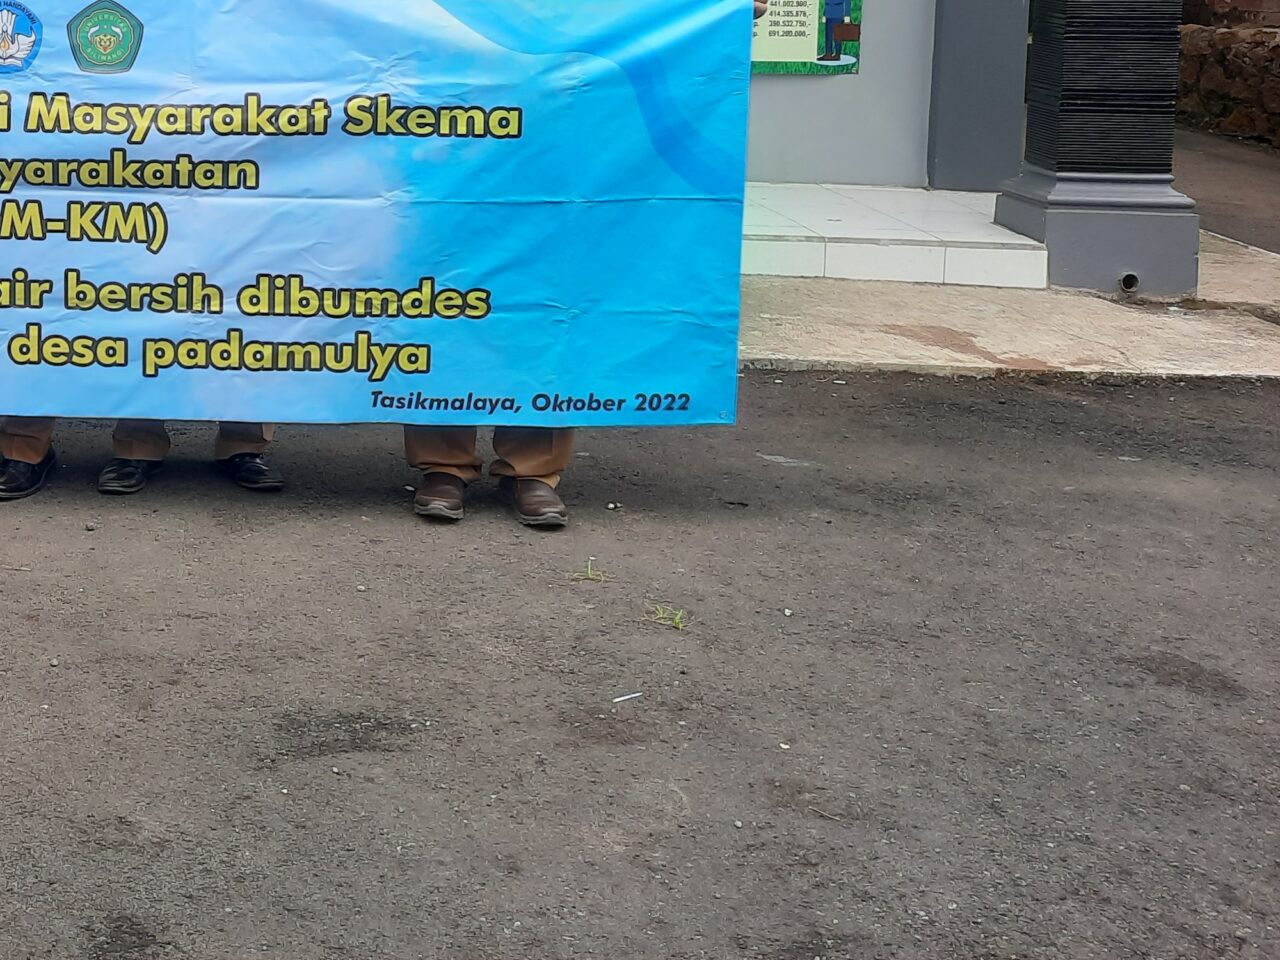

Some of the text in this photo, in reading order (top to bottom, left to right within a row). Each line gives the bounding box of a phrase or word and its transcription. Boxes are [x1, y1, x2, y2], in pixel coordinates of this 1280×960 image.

[3, 0, 37, 25] HANDAYANI
[82, 14, 128, 33] UNIVERSITAS
[85, 47, 125, 62] SILIWANGI
[24, 91, 332, 145] Masyarakat
[341, 93, 524, 139] Skema
[63, 269, 224, 316] bersih
[236, 273, 492, 321] dibumdes
[8, 322, 128, 367] desa
[142, 328, 432, 382] padamulya
[369, 390, 691, 414] Tasikmalaya, Oktober 2022
